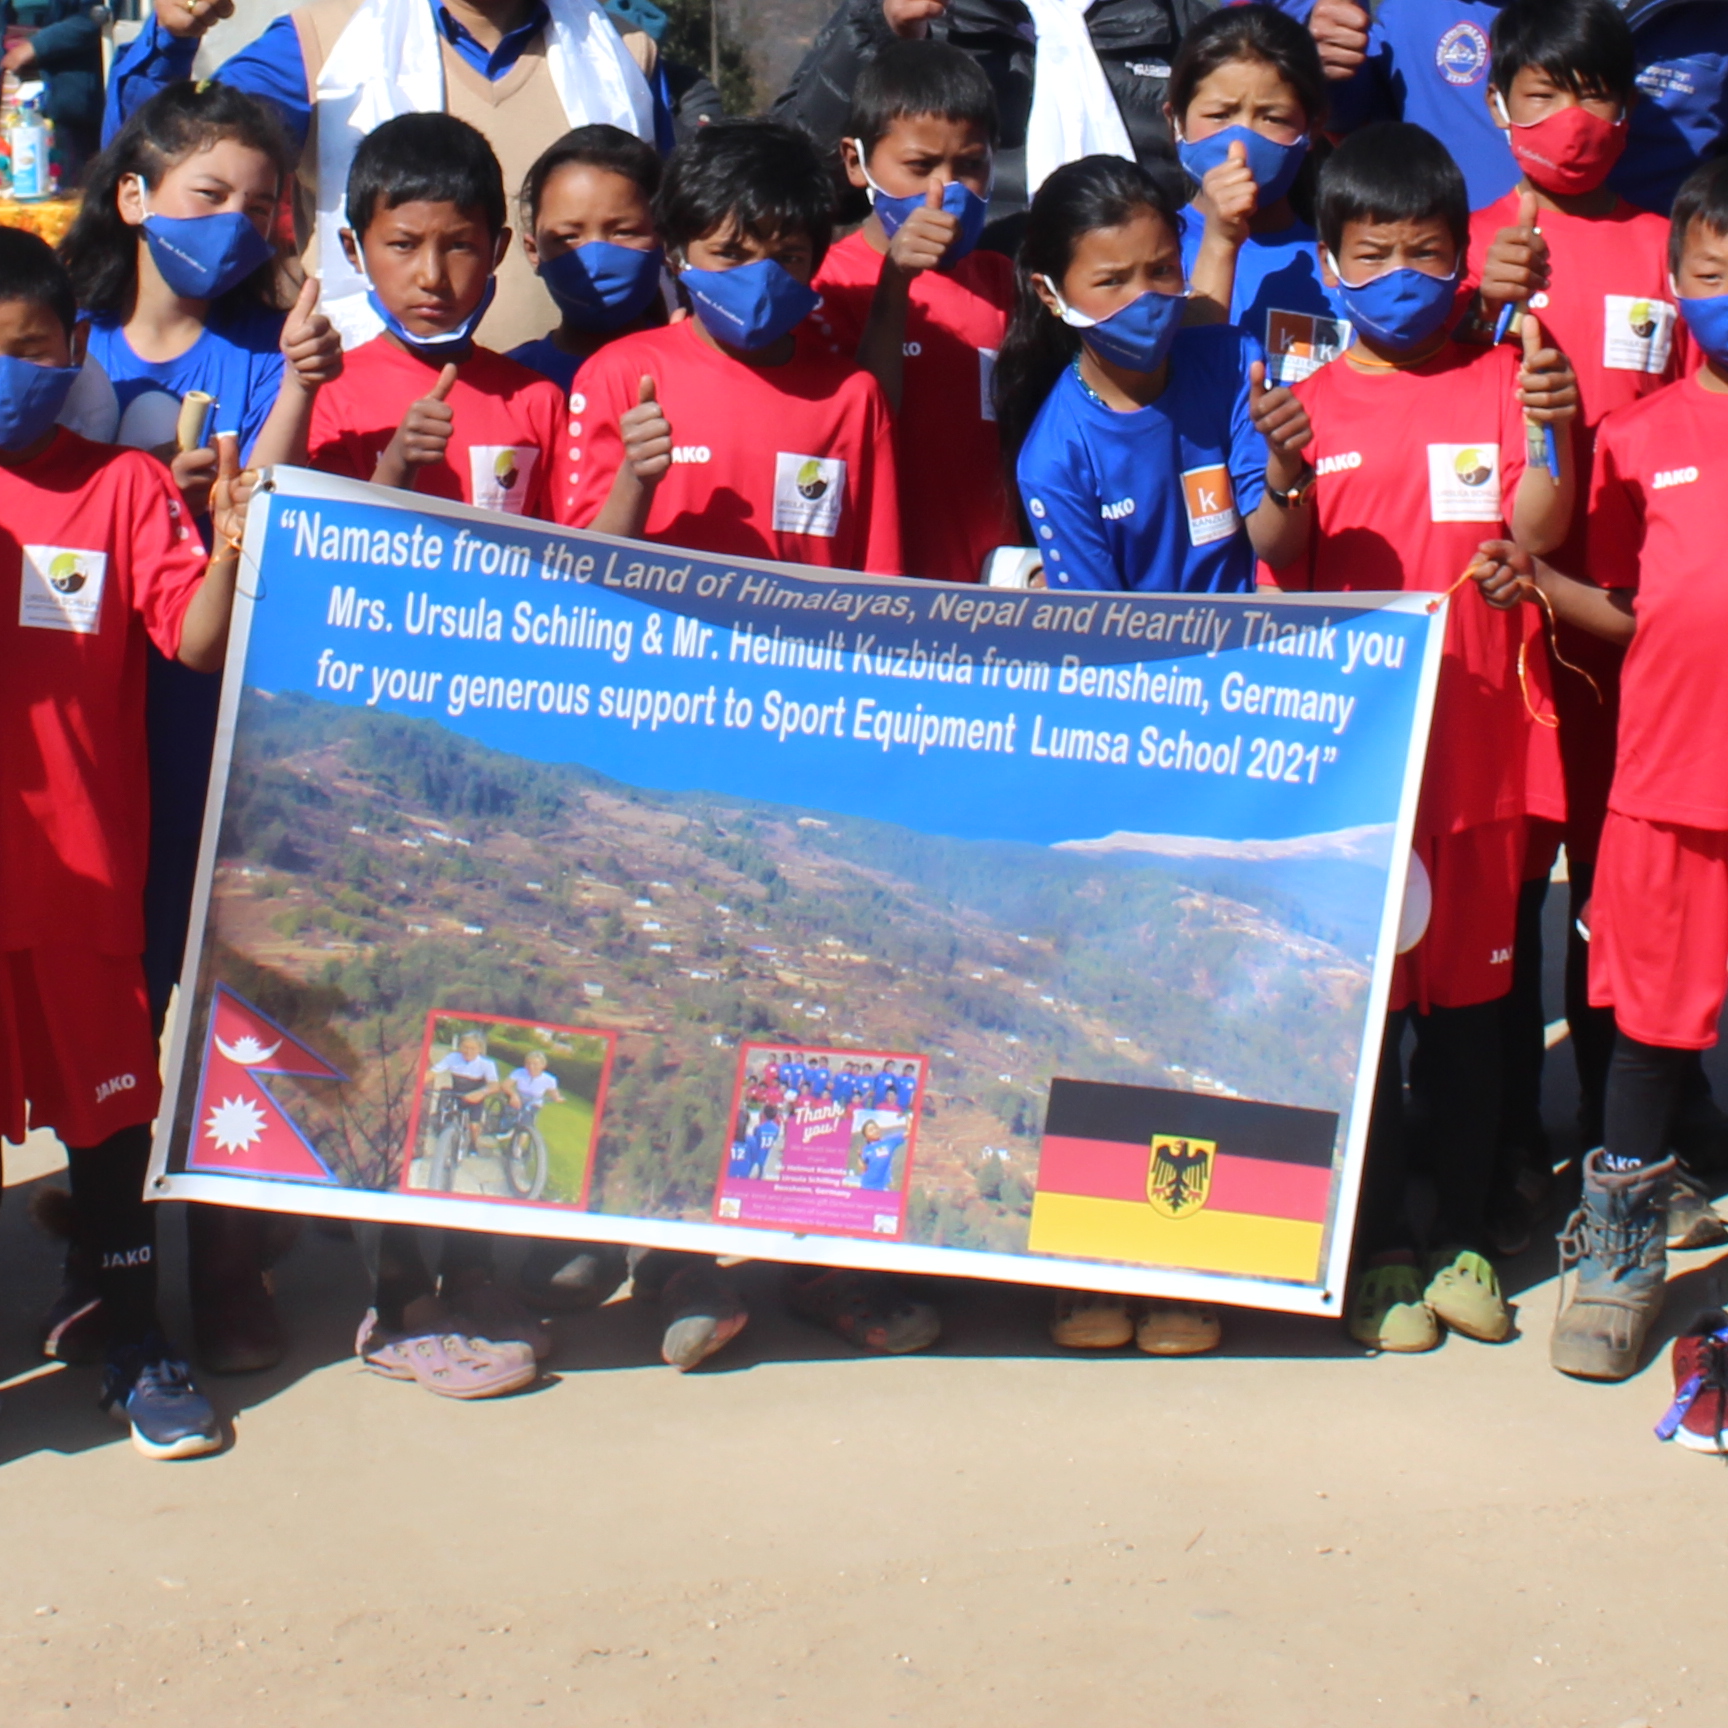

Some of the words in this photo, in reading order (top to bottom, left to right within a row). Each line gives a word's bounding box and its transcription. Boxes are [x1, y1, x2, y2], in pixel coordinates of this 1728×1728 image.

[671, 445, 711, 464] AKO
[1316, 451, 1362, 476] JAKO
[1652, 466, 1699, 489] JAKO
[1101, 497, 1136, 520] AKO
[280, 508, 443, 570] “Namaste
[452, 528, 532, 578] from
[541, 541, 595, 584] the
[603, 551, 692, 595] Land
[696, 571, 734, 598] of
[737, 575, 916, 625] Himalayas,
[928, 592, 1030, 633] Nepal
[1031, 600, 1099, 635] and
[1101, 601, 1232, 658] Heartily
[1241, 610, 1338, 661] Thank
[1340, 627, 1406, 674] you
[326, 583, 394, 633] Mrs.
[404, 589, 503, 642] Ursula
[510, 600, 634, 663] Schiling
[641, 612, 663, 655] &
[672, 615, 719, 660] Mr.
[729, 620, 845, 672] Helmult
[852, 632, 973, 684] Kuzbida
[980, 646, 1050, 691] from
[1057, 654, 1210, 716] Bensheim,
[1220, 670, 1355, 735] Germany
[316, 648, 364, 692] for
[365, 666, 442, 706] your
[447, 671, 591, 717] generous
[598, 683, 716, 731] support
[724, 686, 753, 728] to
[760, 689, 847, 742] Sport
[852, 697, 1017, 755] Equipment
[1030, 714, 1129, 765] Lumsa
[1137, 725, 1242, 775] School
[1245, 737, 1338, 785] 2021”
[95, 1073, 136, 1103] JAKO
[794, 1100, 845, 1125] Thank
[802, 1119, 840, 1144] you!
[101, 1245, 152, 1268] JAKO
